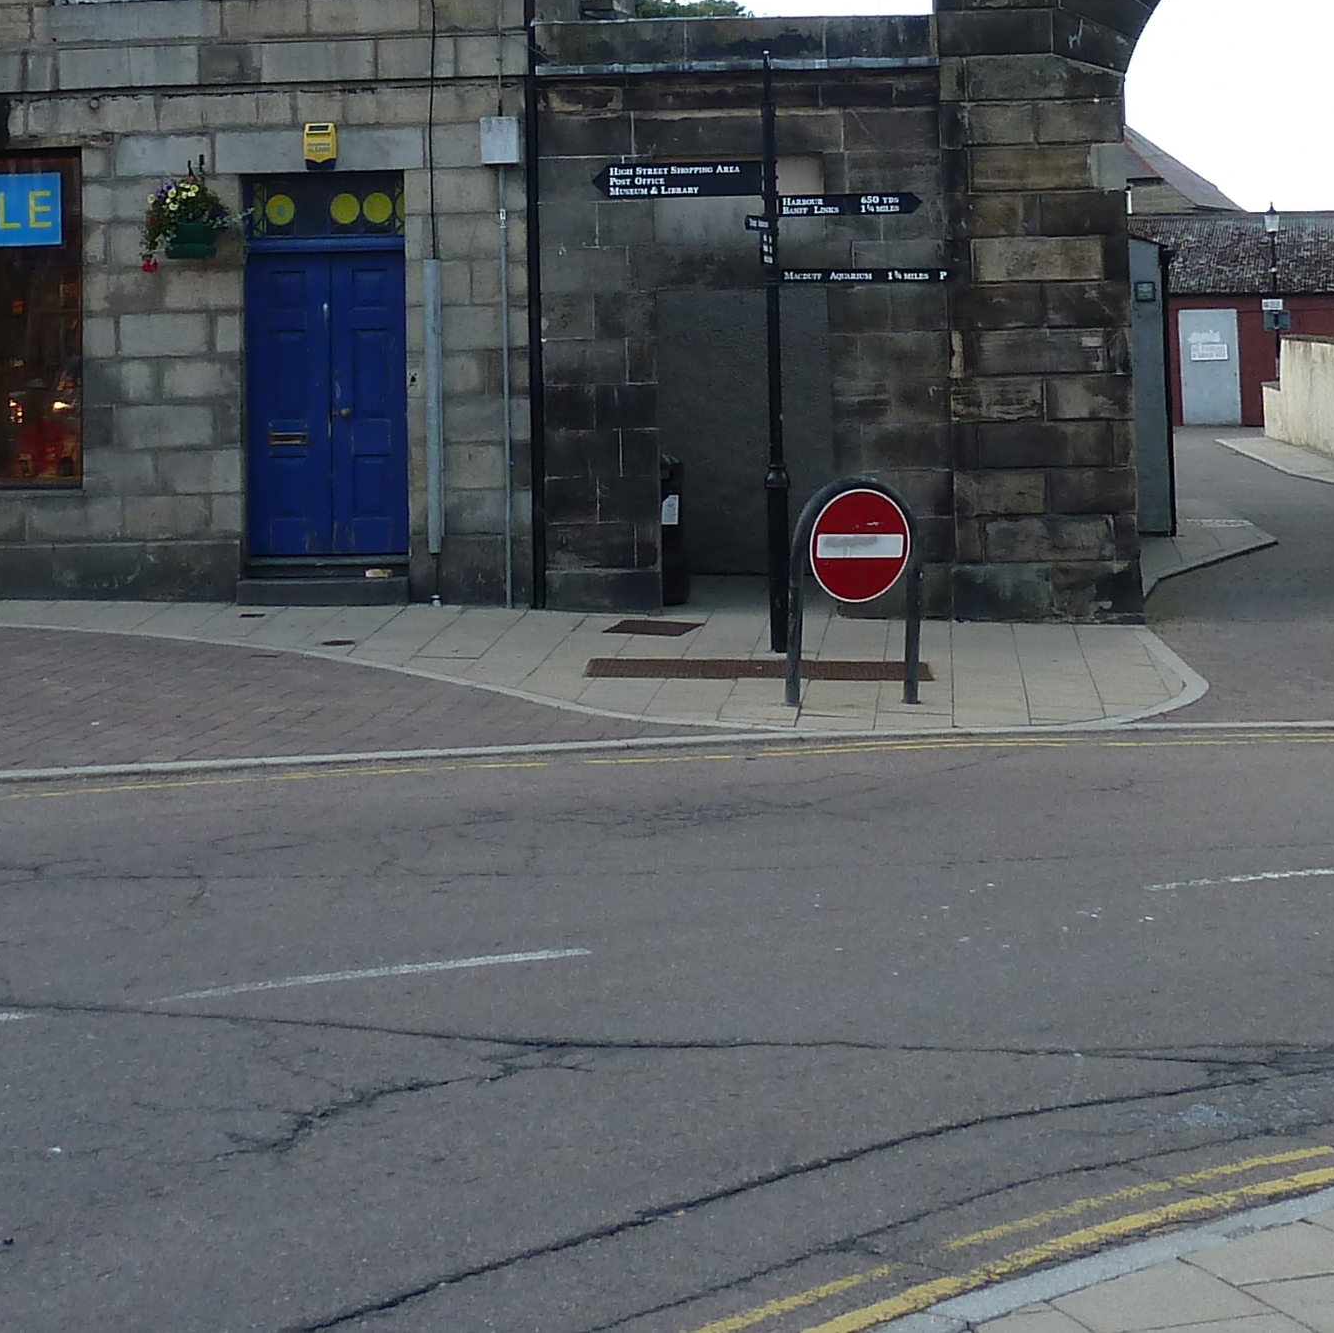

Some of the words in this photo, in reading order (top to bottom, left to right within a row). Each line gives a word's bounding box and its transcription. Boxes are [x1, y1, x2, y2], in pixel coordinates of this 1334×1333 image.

[609, 168, 633, 176] HIGH
[636, 166, 668, 175] STREET
[670, 166, 713, 174] SHOPPING
[716, 165, 740, 174] AREA
[609, 178, 630, 186] POST
[634, 176, 665, 185] OFFICE
[610, 187, 648, 196] MUSEUM
[650, 186, 658, 194] &
[660, 186, 699, 194] LIBRARY
[782, 198, 824, 206] HARBOUR
[782, 206, 808, 214] BANFF
[814, 206, 840, 214] LINKS
[784, 272, 822, 280] MACDUFF
[830, 271, 872, 281] AQUARIUM
[904, 272, 930, 280] MILES
[939, 271, 948, 280] P
